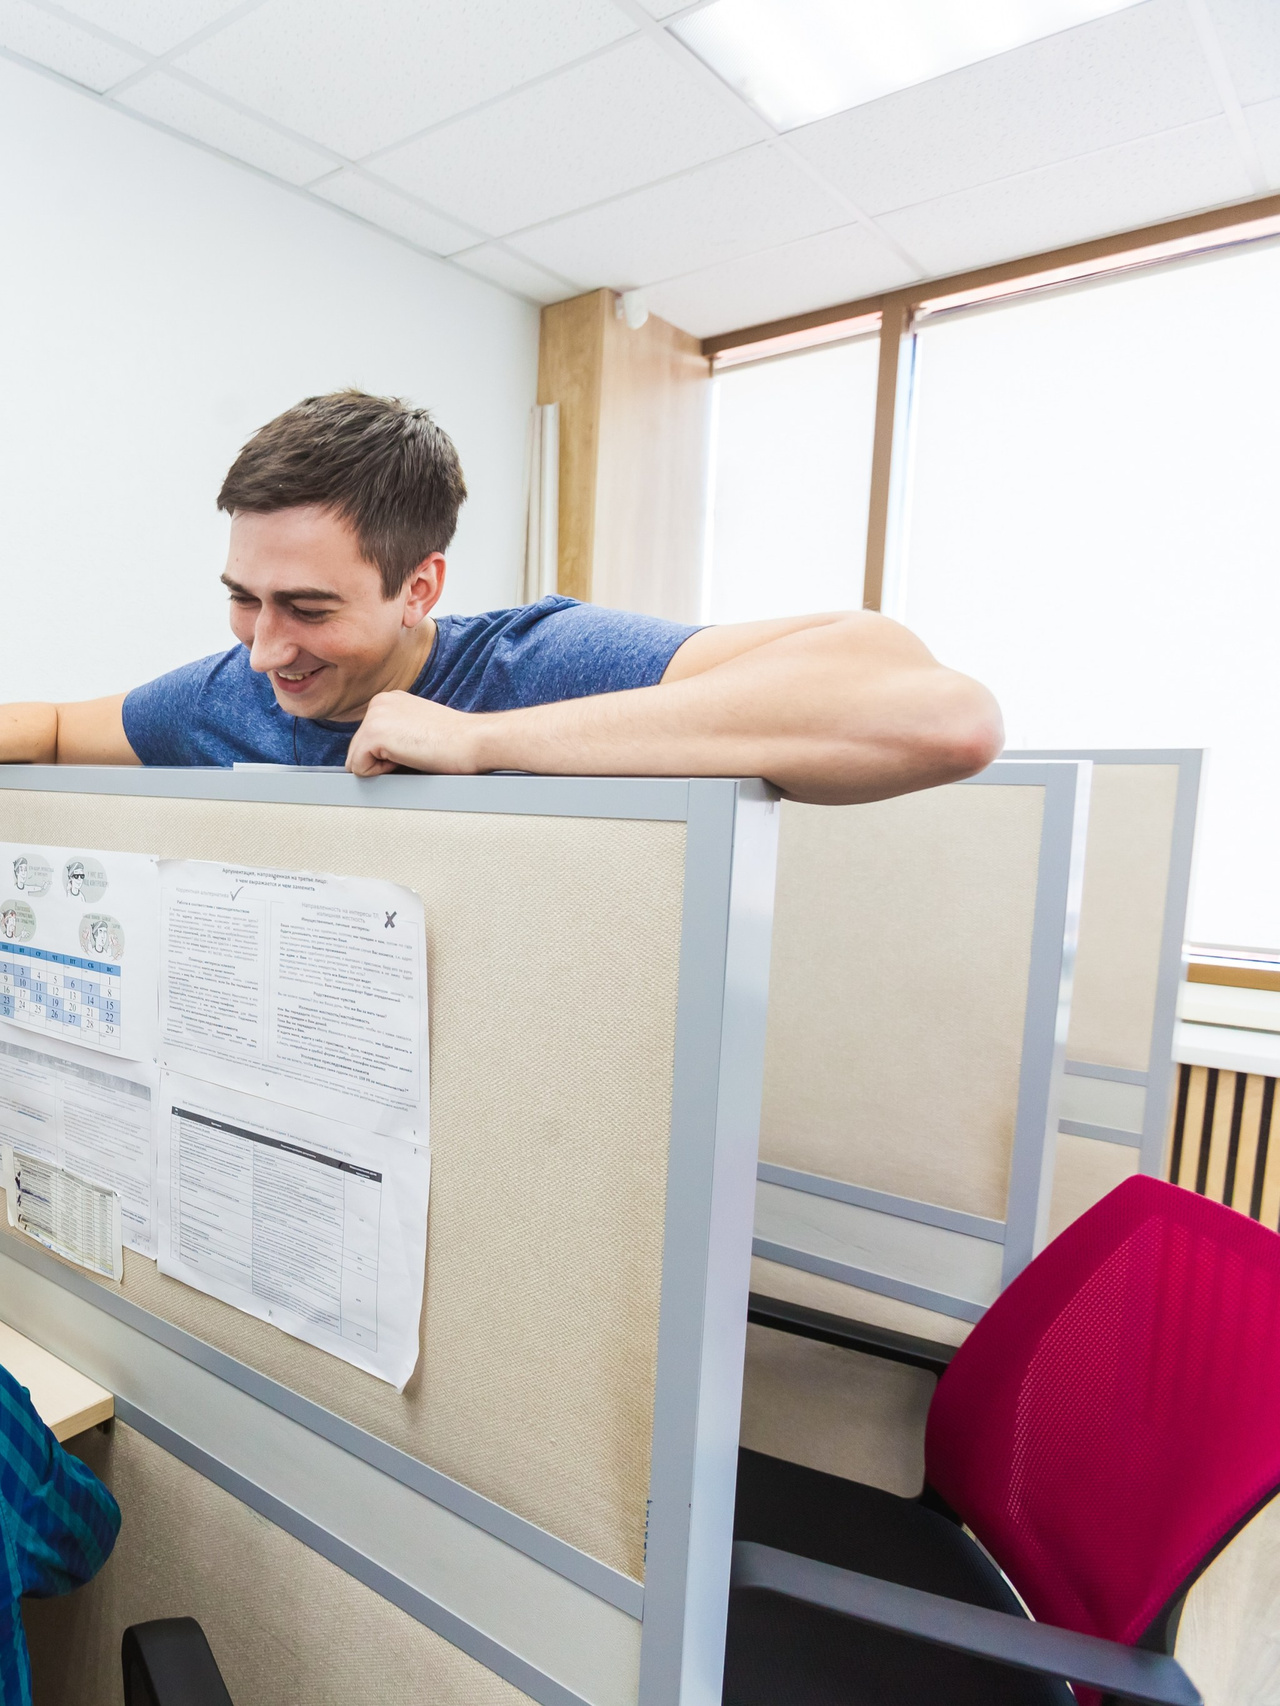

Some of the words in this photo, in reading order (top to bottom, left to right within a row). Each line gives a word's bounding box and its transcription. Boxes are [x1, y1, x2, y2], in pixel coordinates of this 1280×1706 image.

[108, 977, 111, 985] 1
[35, 994, 42, 1002] 18
[52, 998, 59, 1007] 19
[69, 1003, 76, 1012] 20
[87, 1008, 93, 1016] 21
[106, 1013, 114, 1022] 22
[36, 983, 42, 991] 11
[52, 987, 59, 996] 12
[70, 991, 77, 1000] 13
[87, 996, 94, 1004] 14
[106, 1001, 114, 1010] 15
[3, 1007, 10, 1015] 30
[51, 1010, 58, 1018] 26
[68, 1015, 76, 1023] 27
[86, 1020, 94, 1028] 28
[106, 1025, 114, 1034] 29
